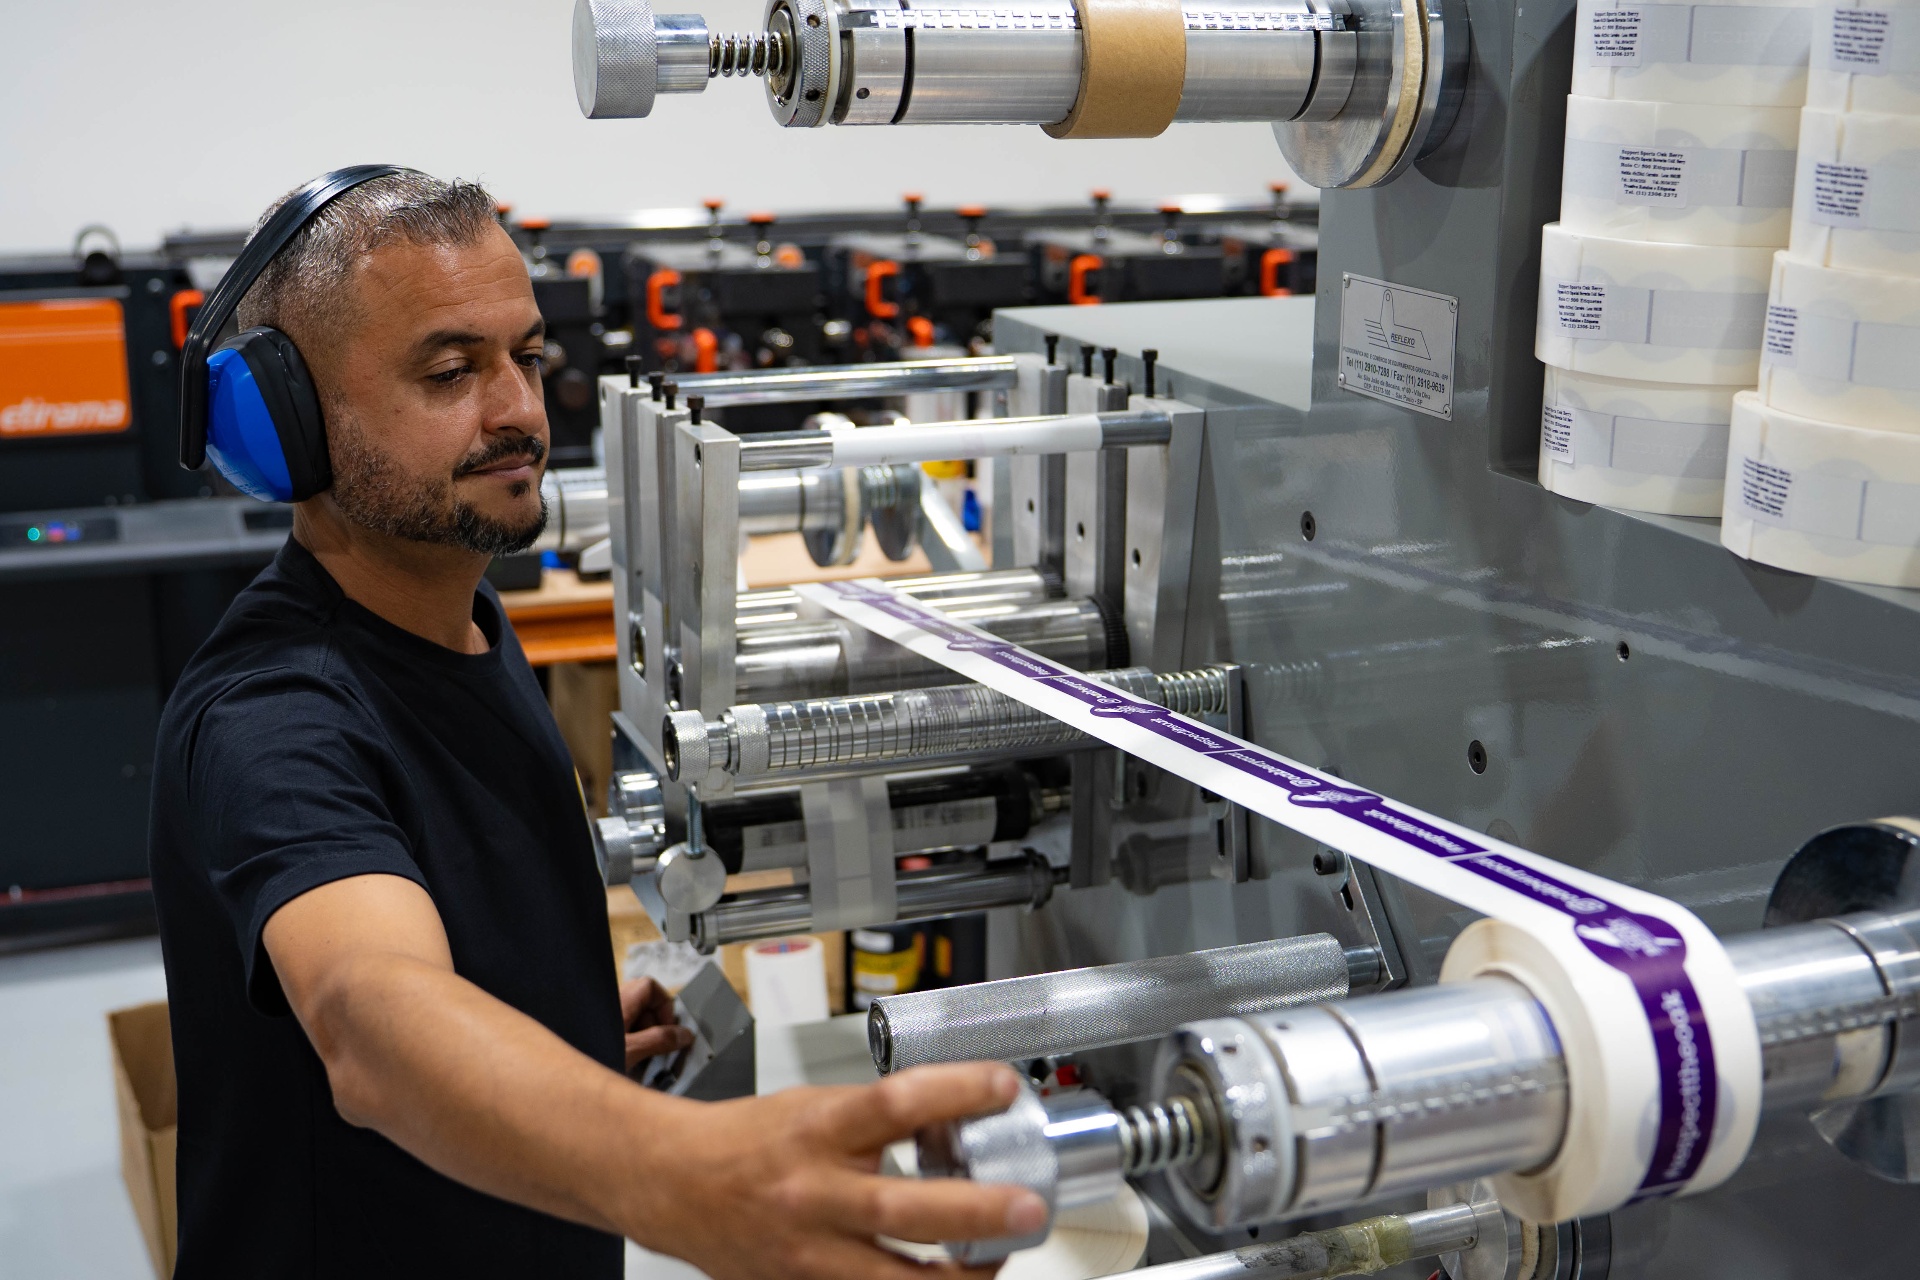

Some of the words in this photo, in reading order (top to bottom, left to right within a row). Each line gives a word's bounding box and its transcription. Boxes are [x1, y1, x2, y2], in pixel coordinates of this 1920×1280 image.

[1391, 333, 1415, 345] REFLEXO
[1355, 360, 1364, 371] (11)
[1393, 371, 1404, 382] Fax:
[1406, 374, 1416, 387] (11)
